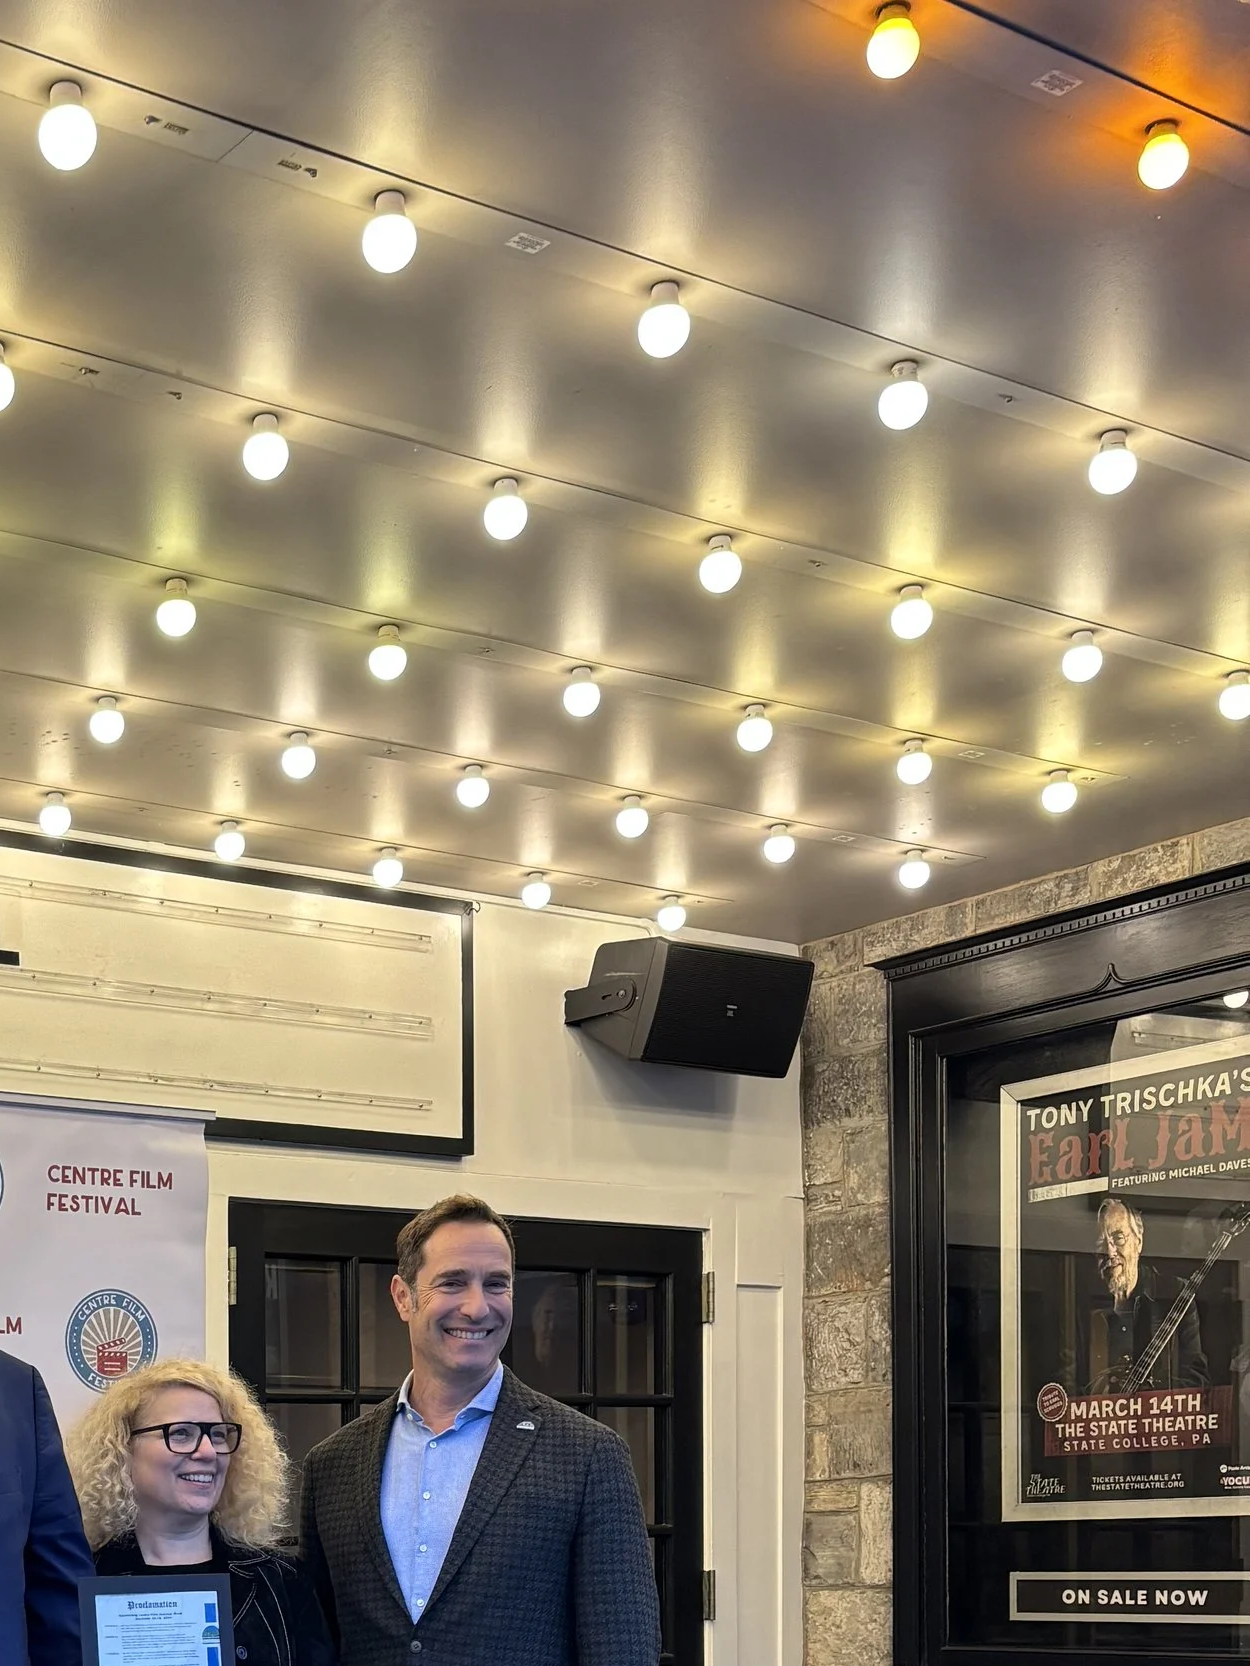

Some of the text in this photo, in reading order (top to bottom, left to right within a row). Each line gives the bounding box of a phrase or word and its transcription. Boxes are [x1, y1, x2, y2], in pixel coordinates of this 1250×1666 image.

[1027, 1099, 1093, 1131] TONY
[47, 1165, 173, 1191] CENTRE FILM
[1112, 1171, 1166, 1188] FEATURING
[1169, 1162, 1217, 1178] MICHAEL
[47, 1193, 142, 1216] FESTIVAL
[78, 1294, 146, 1322] CENTRE FILM
[1071, 1393, 1201, 1420] MARCH 14TH
[1055, 1414, 1219, 1438] THE STATE THEATRE
[1063, 1434, 1211, 1452] STATE COLLEGE, PA
[1029, 1478, 1060, 1488] STATE
[1091, 1480, 1185, 1491] THESTATETHEATRE.ORG
[1092, 1473, 1181, 1484] TICKETS AVAILABLE AT
[1026, 1485, 1066, 1495] THEATRE
[127, 1600, 178, 1611] Proclamation
[1061, 1589, 1209, 1606] ON SALE NOW
